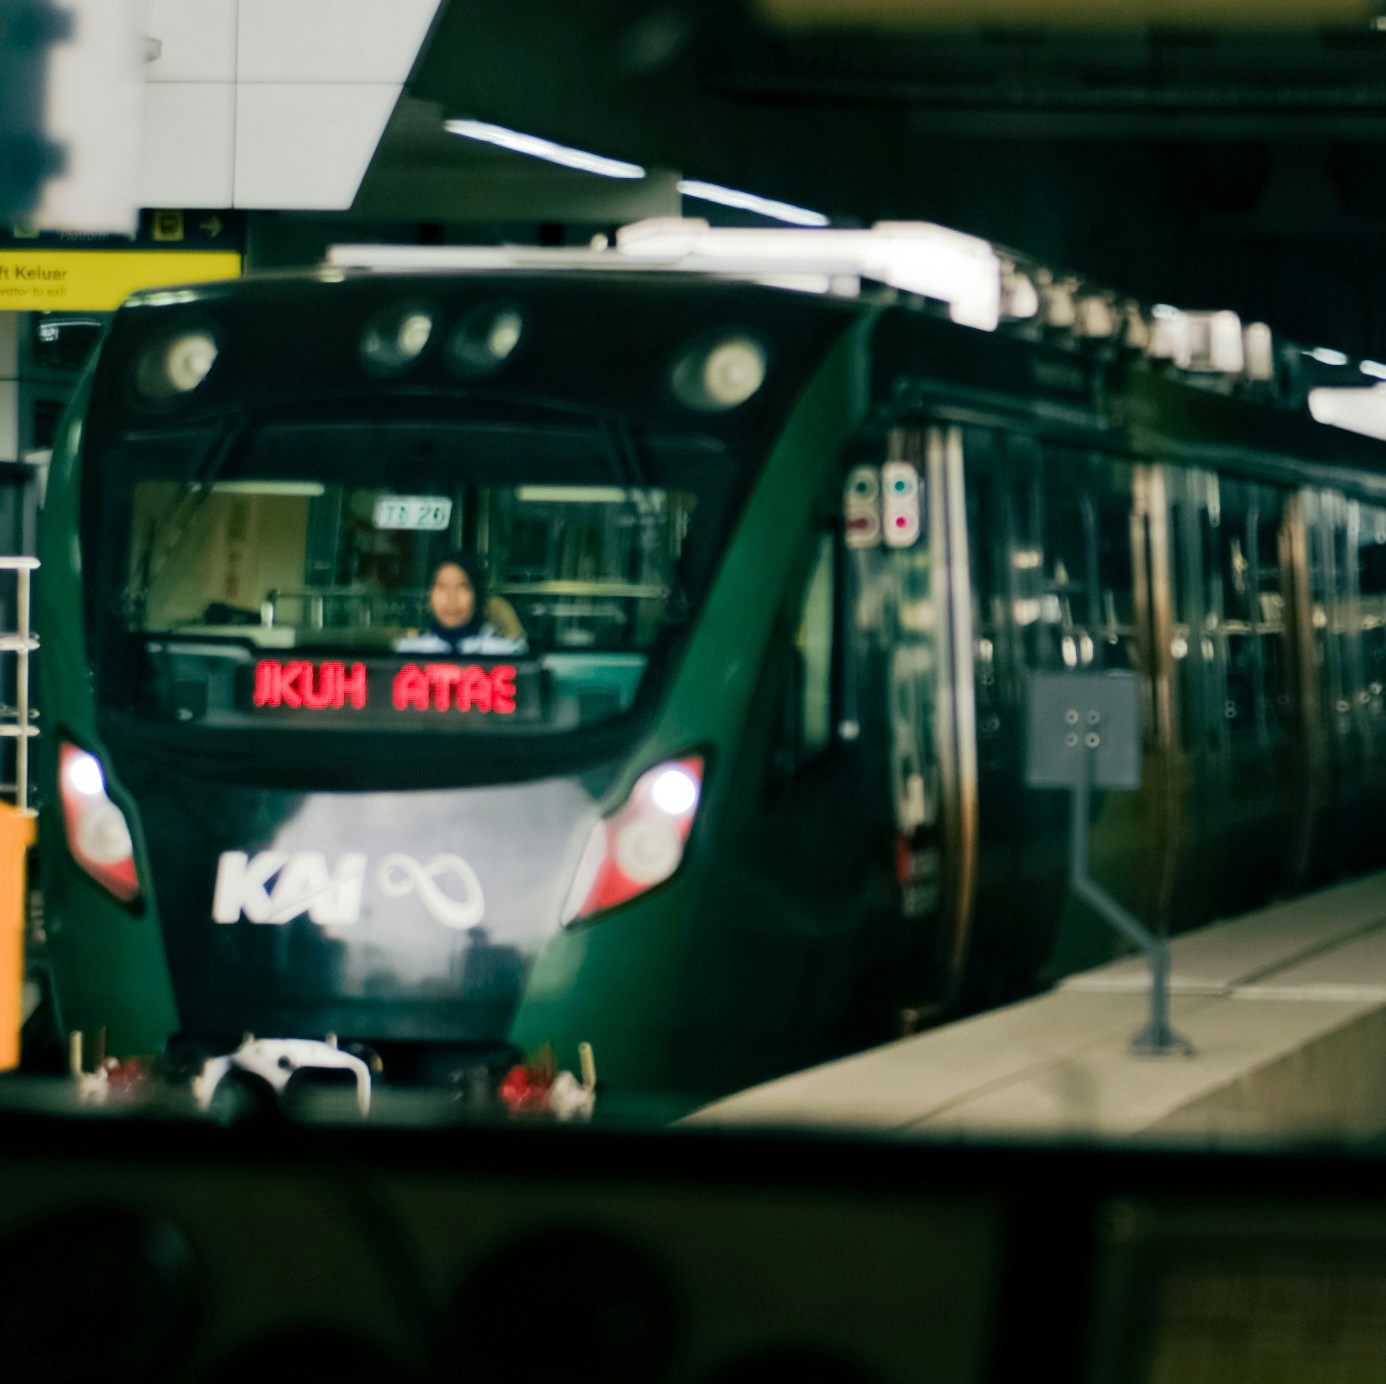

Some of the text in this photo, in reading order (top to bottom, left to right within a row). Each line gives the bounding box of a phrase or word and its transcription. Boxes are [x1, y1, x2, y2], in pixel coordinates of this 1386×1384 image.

[15, 264, 68, 281] Keluar
[33, 287, 45, 297] to
[212, 850, 368, 925] KAI
